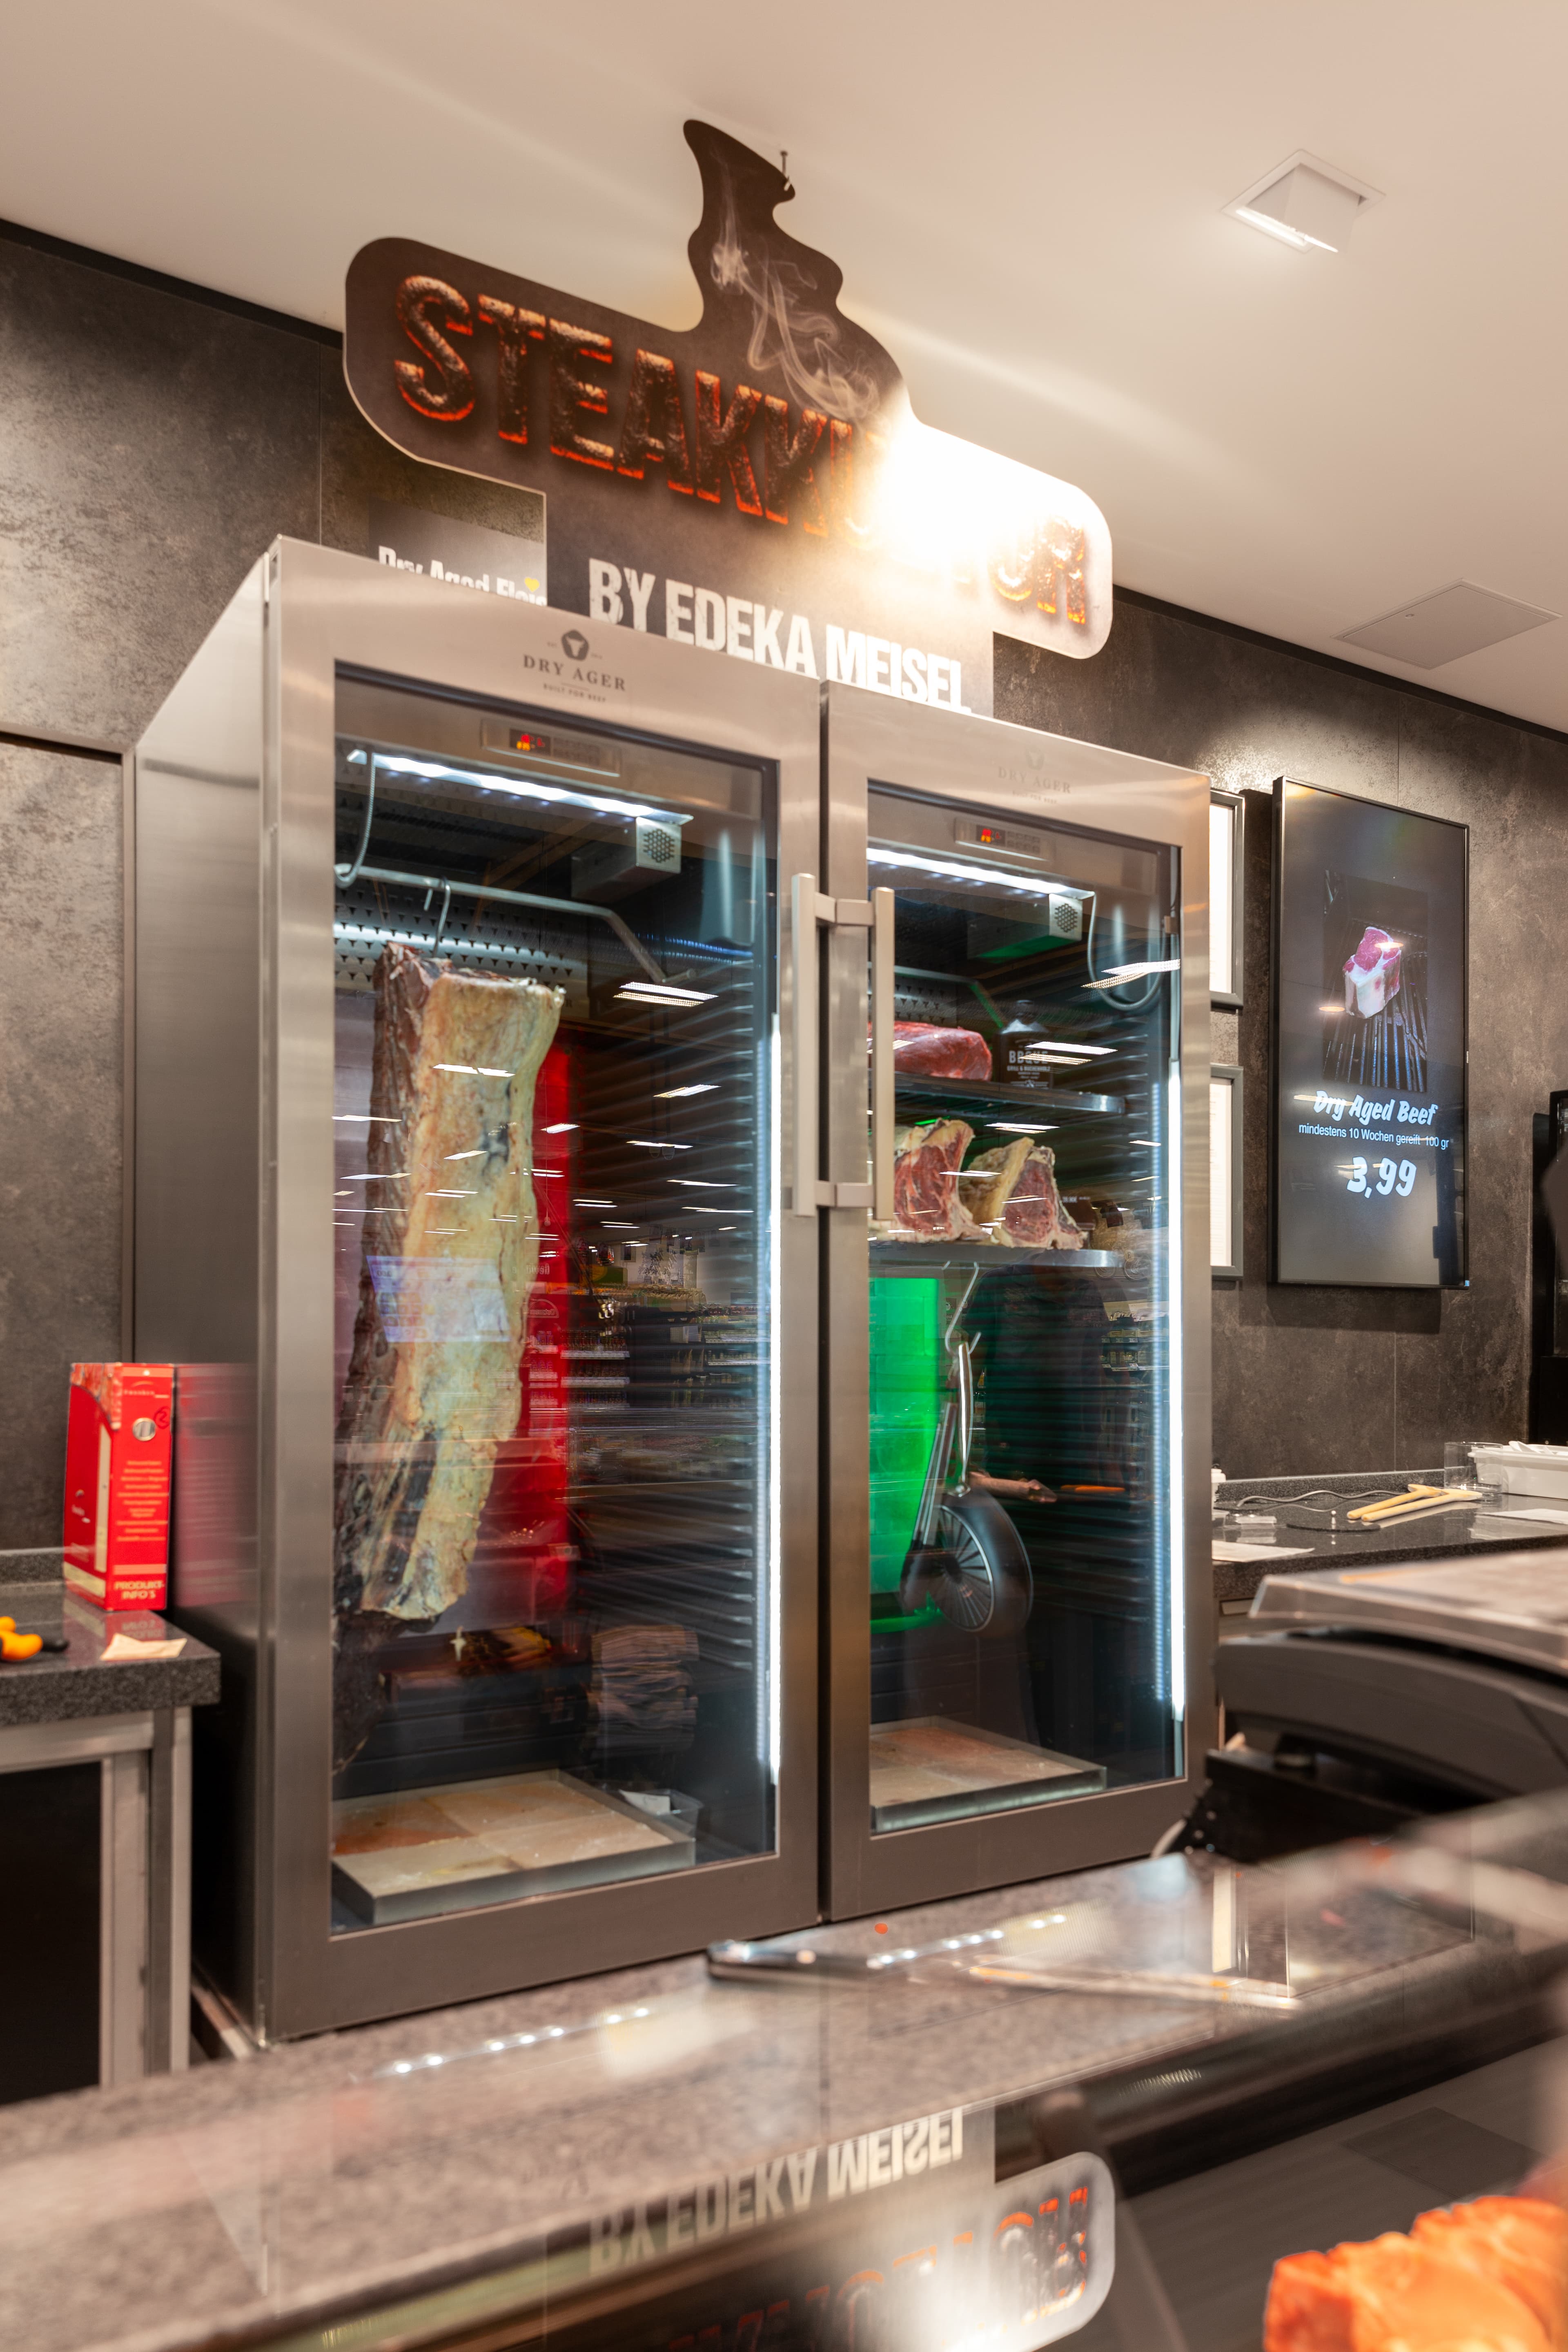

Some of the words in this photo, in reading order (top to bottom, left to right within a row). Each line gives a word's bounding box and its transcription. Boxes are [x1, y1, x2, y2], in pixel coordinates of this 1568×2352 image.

[394, 274, 1086, 625] STEAKKUUR
[589, 558, 655, 633] BY
[666, 579, 818, 679] EDEKA
[826, 624, 971, 714] MEISEL
[523, 654, 564, 676] DRY
[573, 667, 626, 691] AGER
[1313, 1090, 1346, 1121] Dry
[1348, 1094, 1395, 1125] Aged
[1396, 1100, 1439, 1125] Beef
[1298, 1123, 1347, 1138] mindestens
[1349, 1128, 1359, 1139] 10
[1361, 1128, 1394, 1143] Wochen
[1396, 1134, 1421, 1145] gereift
[1425, 1136, 1439, 1147] 100
[1441, 1138, 1449, 1150] gr
[1347, 1156, 1417, 1199] 3,99
